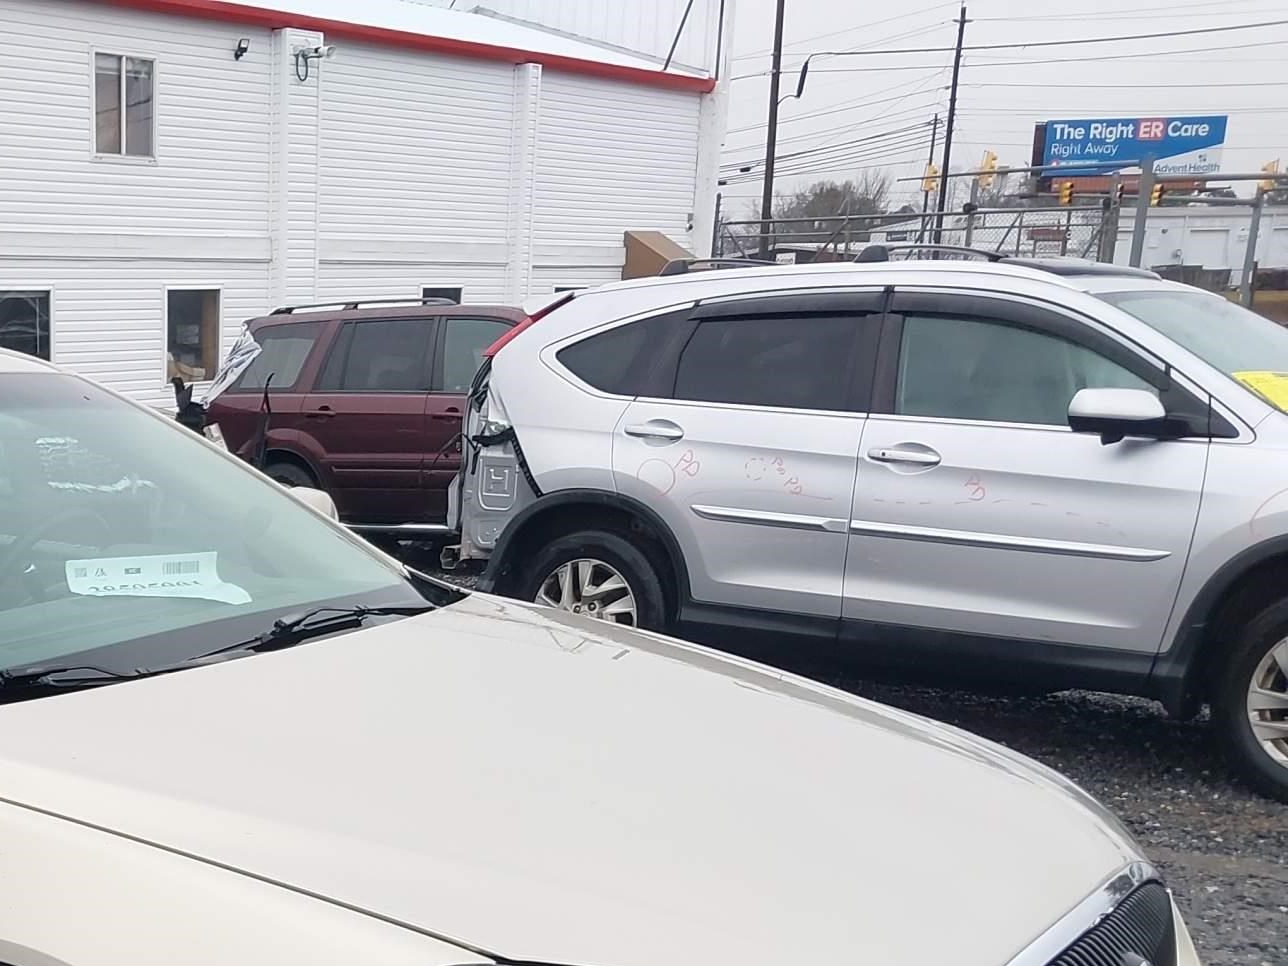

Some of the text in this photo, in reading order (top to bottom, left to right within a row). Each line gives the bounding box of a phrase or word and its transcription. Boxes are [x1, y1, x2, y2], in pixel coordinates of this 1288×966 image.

[1053, 120, 1210, 143] The Right ER Care
[1051, 141, 1119, 158] Right Away
